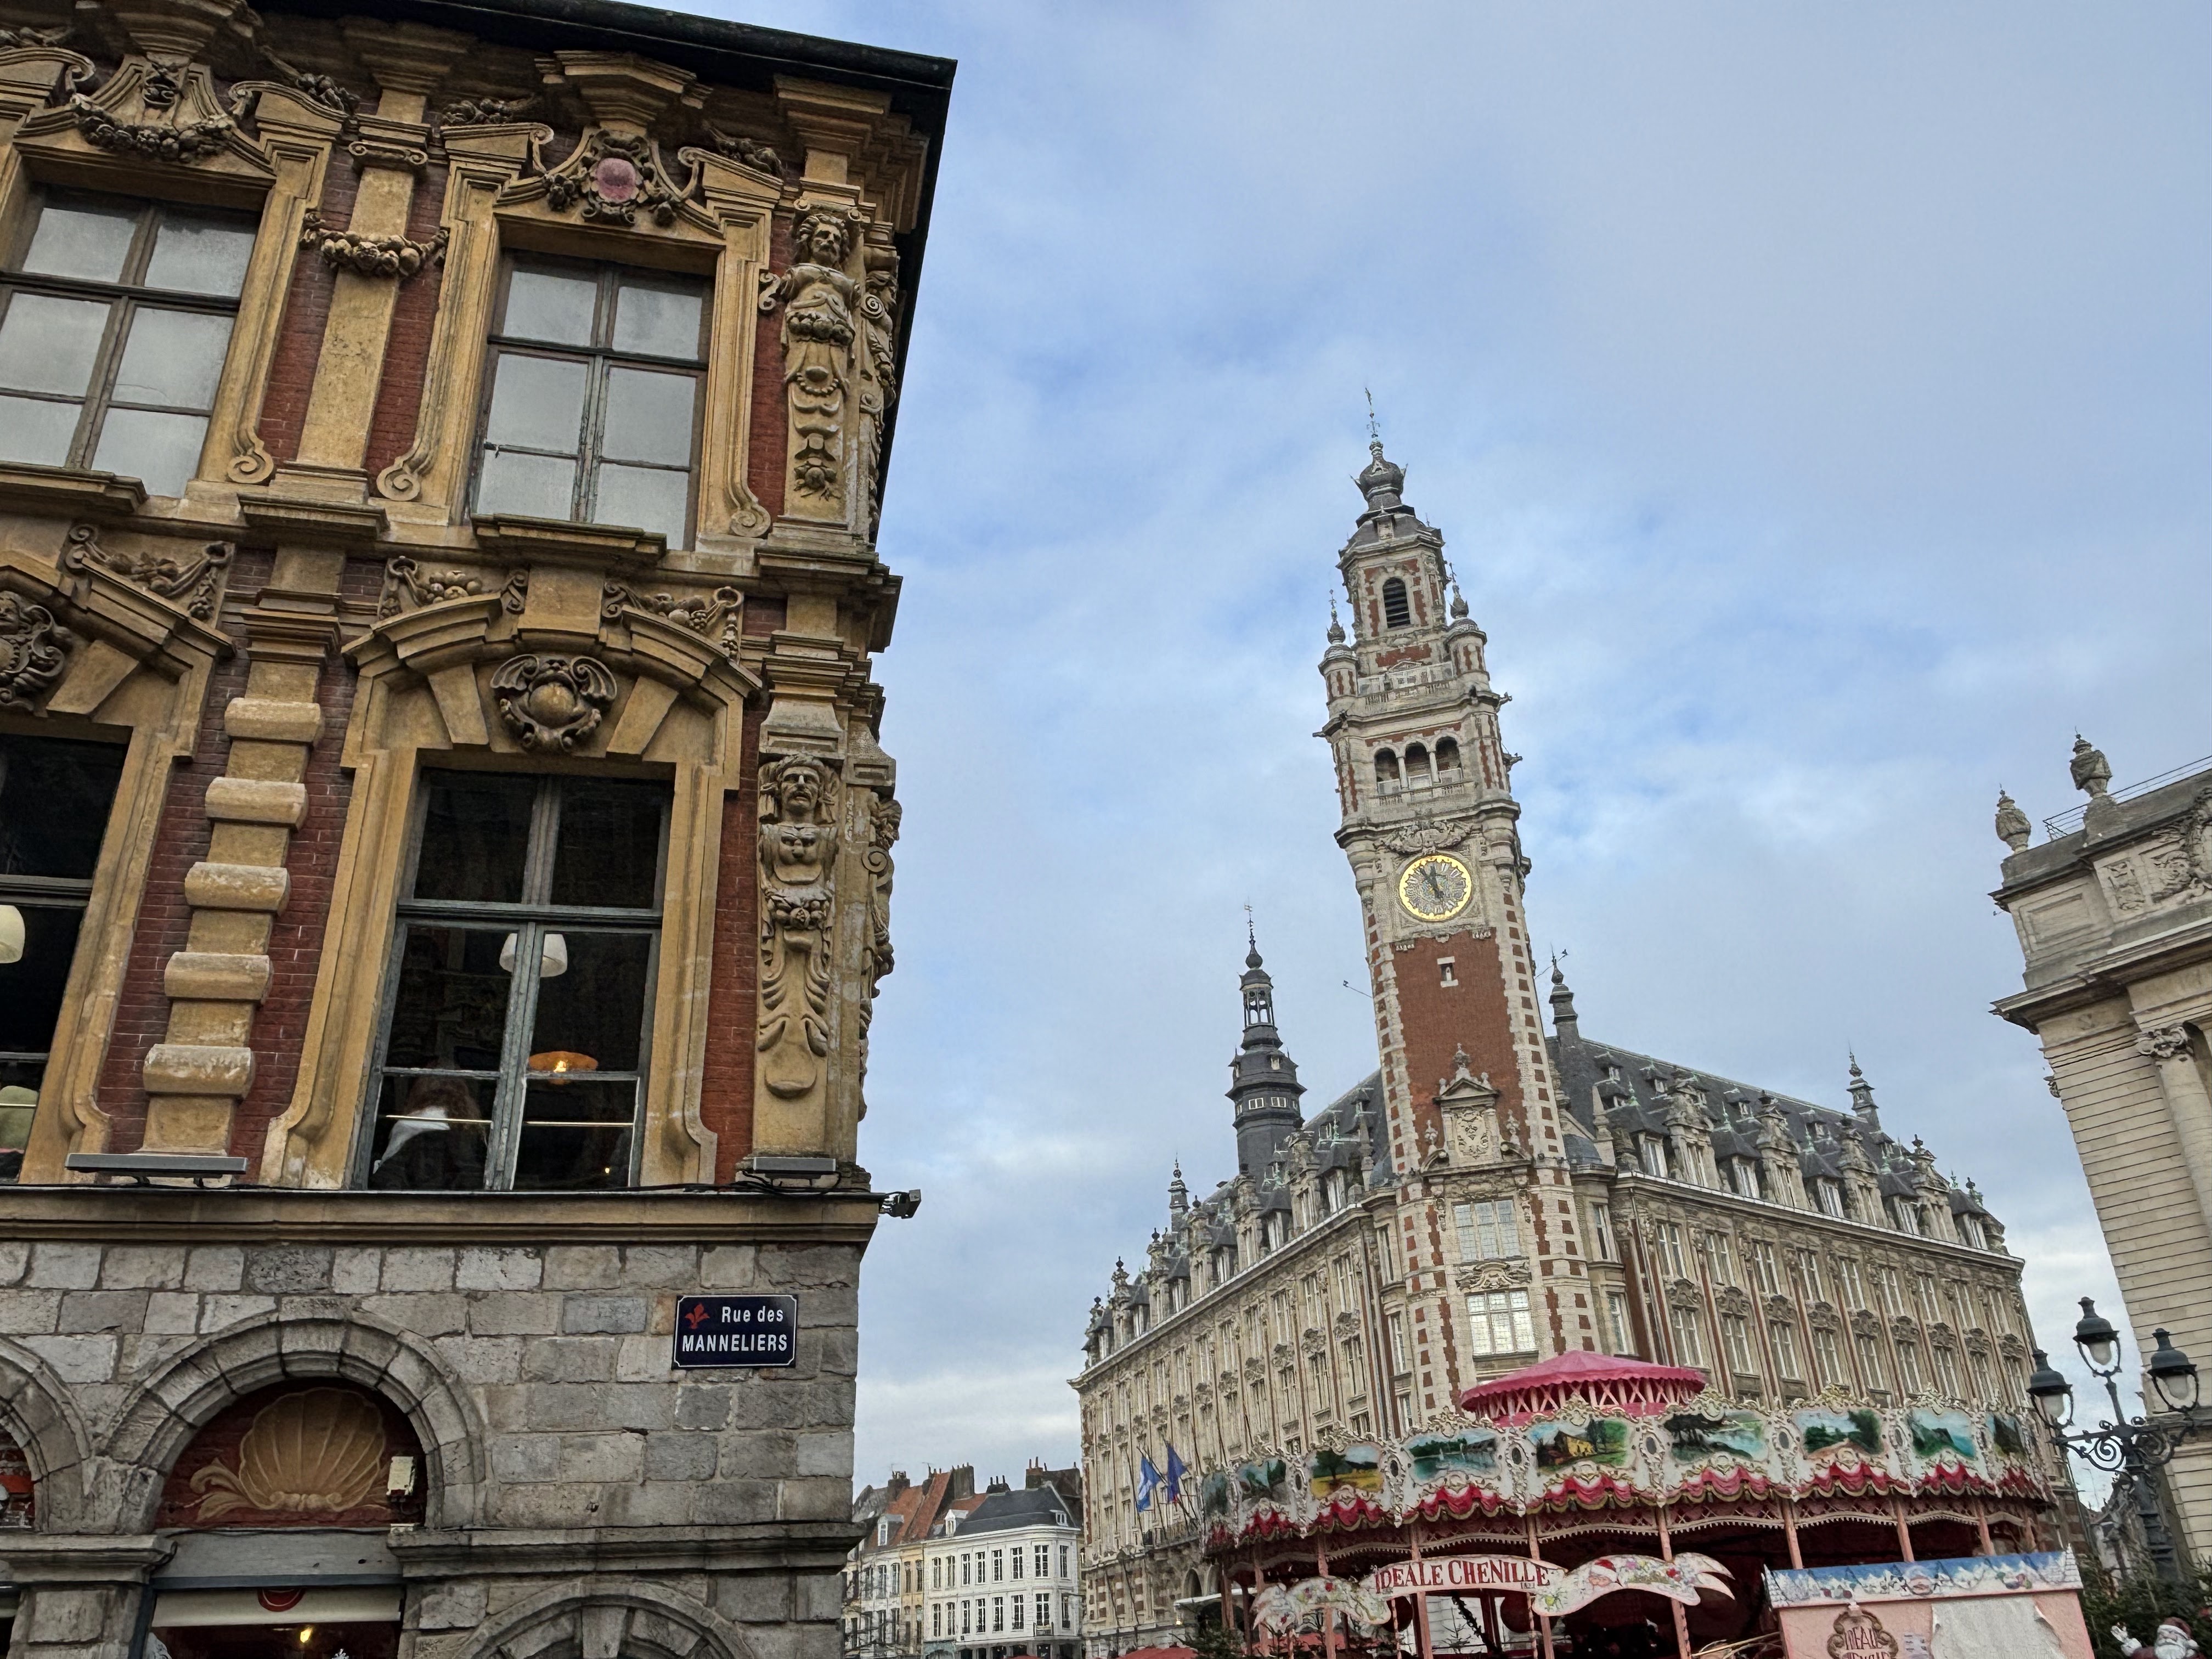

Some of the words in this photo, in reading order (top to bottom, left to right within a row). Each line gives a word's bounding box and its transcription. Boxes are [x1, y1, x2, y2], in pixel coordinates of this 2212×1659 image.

[721, 1306, 751, 1323] Rue
[758, 1305, 783, 1323] des
[682, 1334, 787, 1352] MANNELIERS
[1374, 1562, 1443, 1594] IDEALE
[1448, 1560, 1550, 1587] CHENILLE
